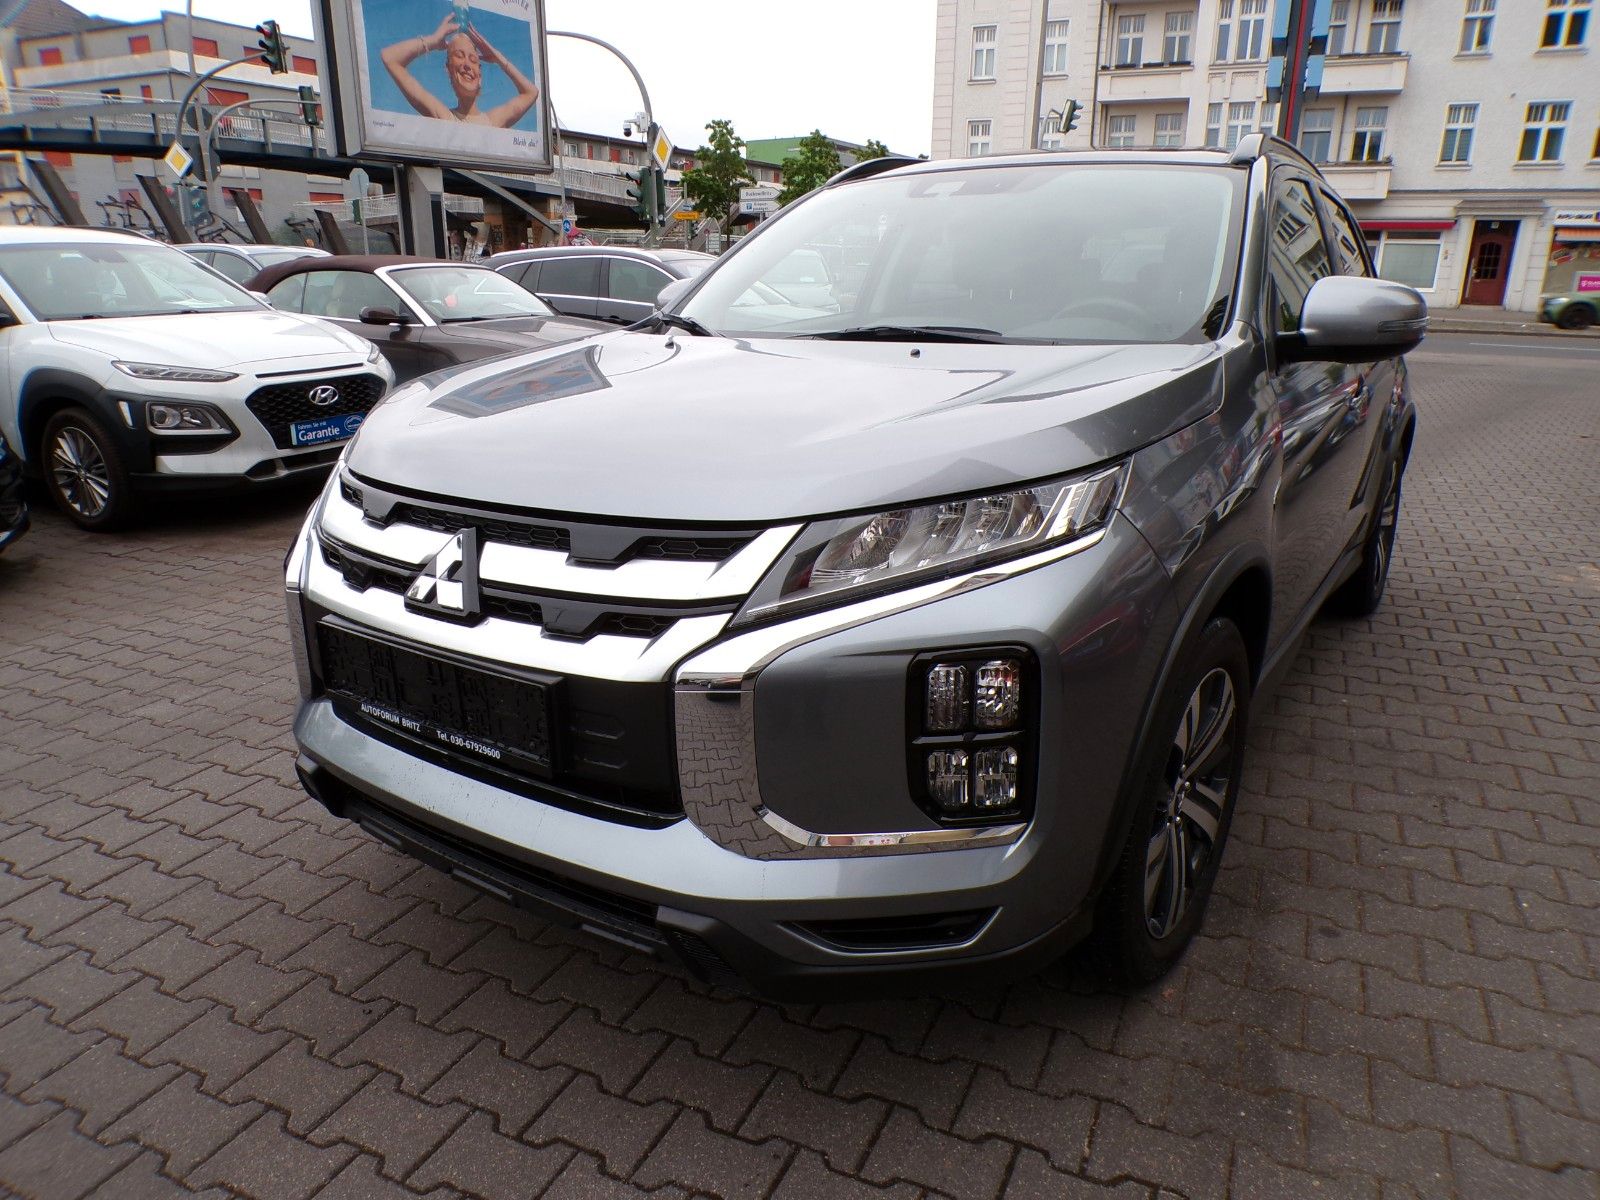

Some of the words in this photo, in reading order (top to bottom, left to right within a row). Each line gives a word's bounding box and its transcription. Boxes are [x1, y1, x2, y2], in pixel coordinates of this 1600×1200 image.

[298, 425, 340, 441] Garantie
[360, 702, 400, 725] AUTOFORUM
[401, 718, 421, 733] BRITZ
[436, 730, 450, 743] Tel.
[450, 735, 501, 760] 030-67929600
